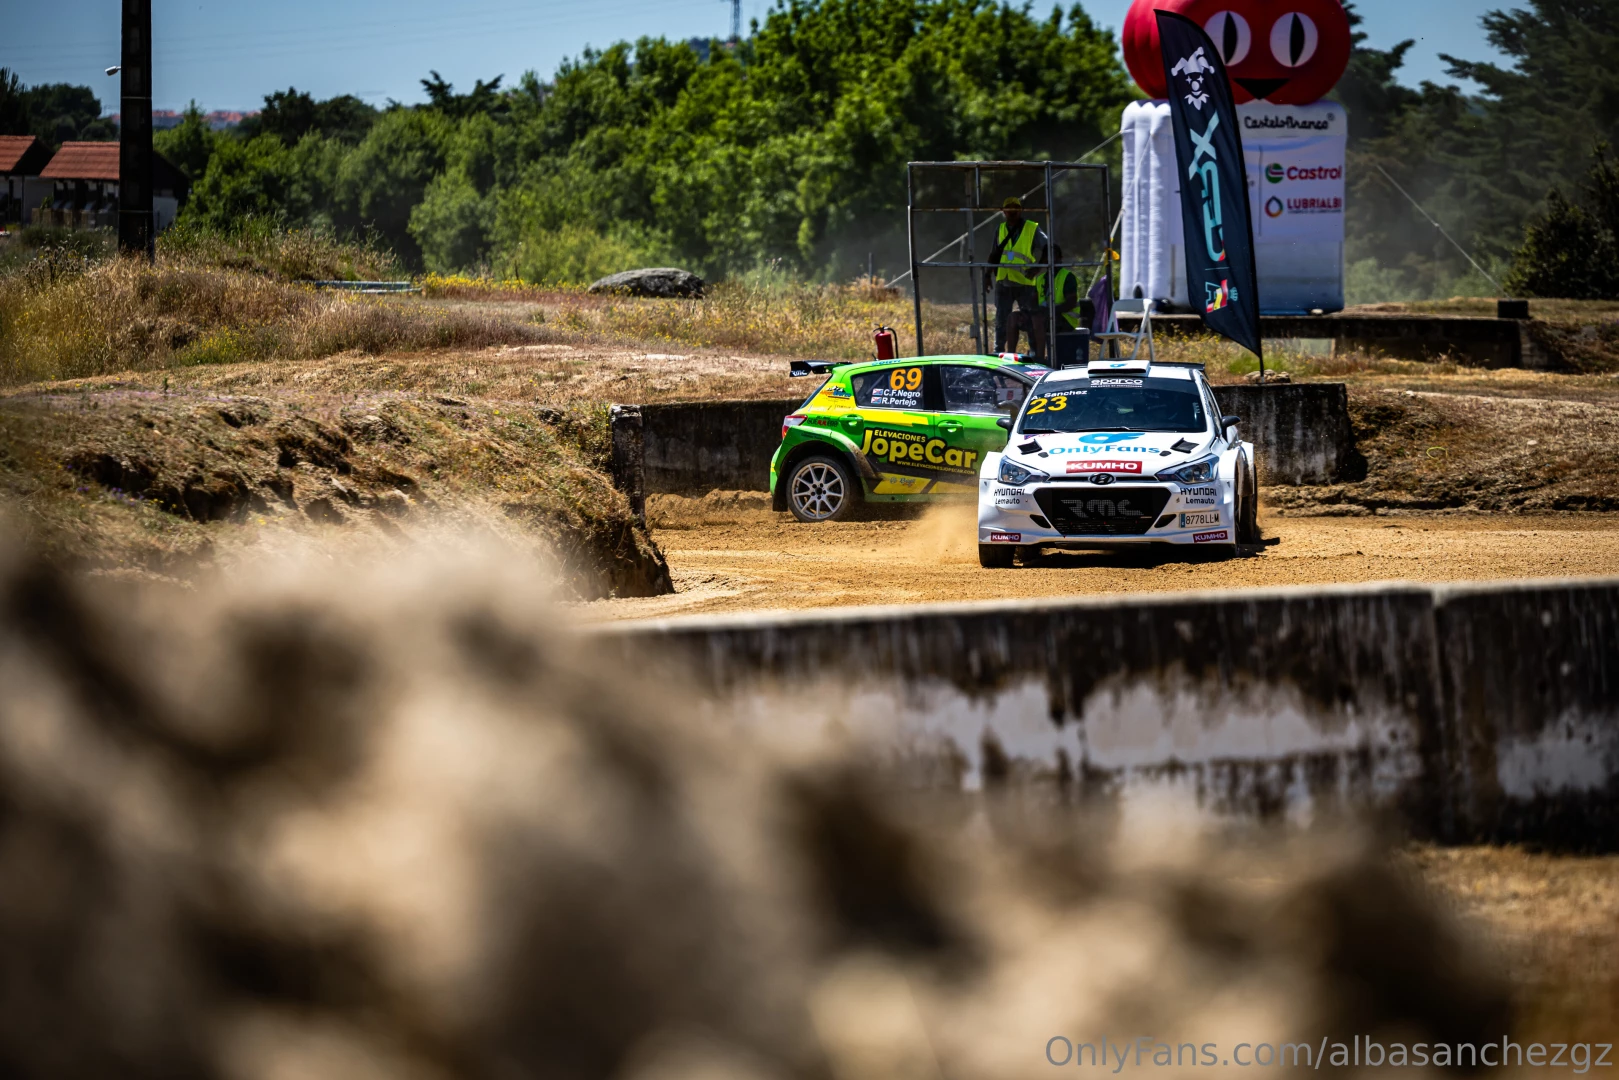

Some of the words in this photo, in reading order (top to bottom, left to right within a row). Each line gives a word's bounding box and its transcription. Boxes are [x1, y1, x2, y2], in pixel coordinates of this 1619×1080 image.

[1287, 165, 1342, 180] Castrol
[890, 367, 922, 391] 69
[883, 389, 921, 399] C.F.Negro
[1044, 390, 1088, 398] Sanchez
[881, 397, 917, 407] R.Pertejo
[1026, 395, 1068, 415] 23
[874, 429, 926, 443] ELEVACIONES
[862, 429, 977, 468] JopeCar
[1049, 445, 1160, 455] OnlyFans
[1069, 462, 1138, 470] KUMHO
[1185, 497, 1215, 505] Lemauto
[1194, 532, 1226, 541] KUMHO
